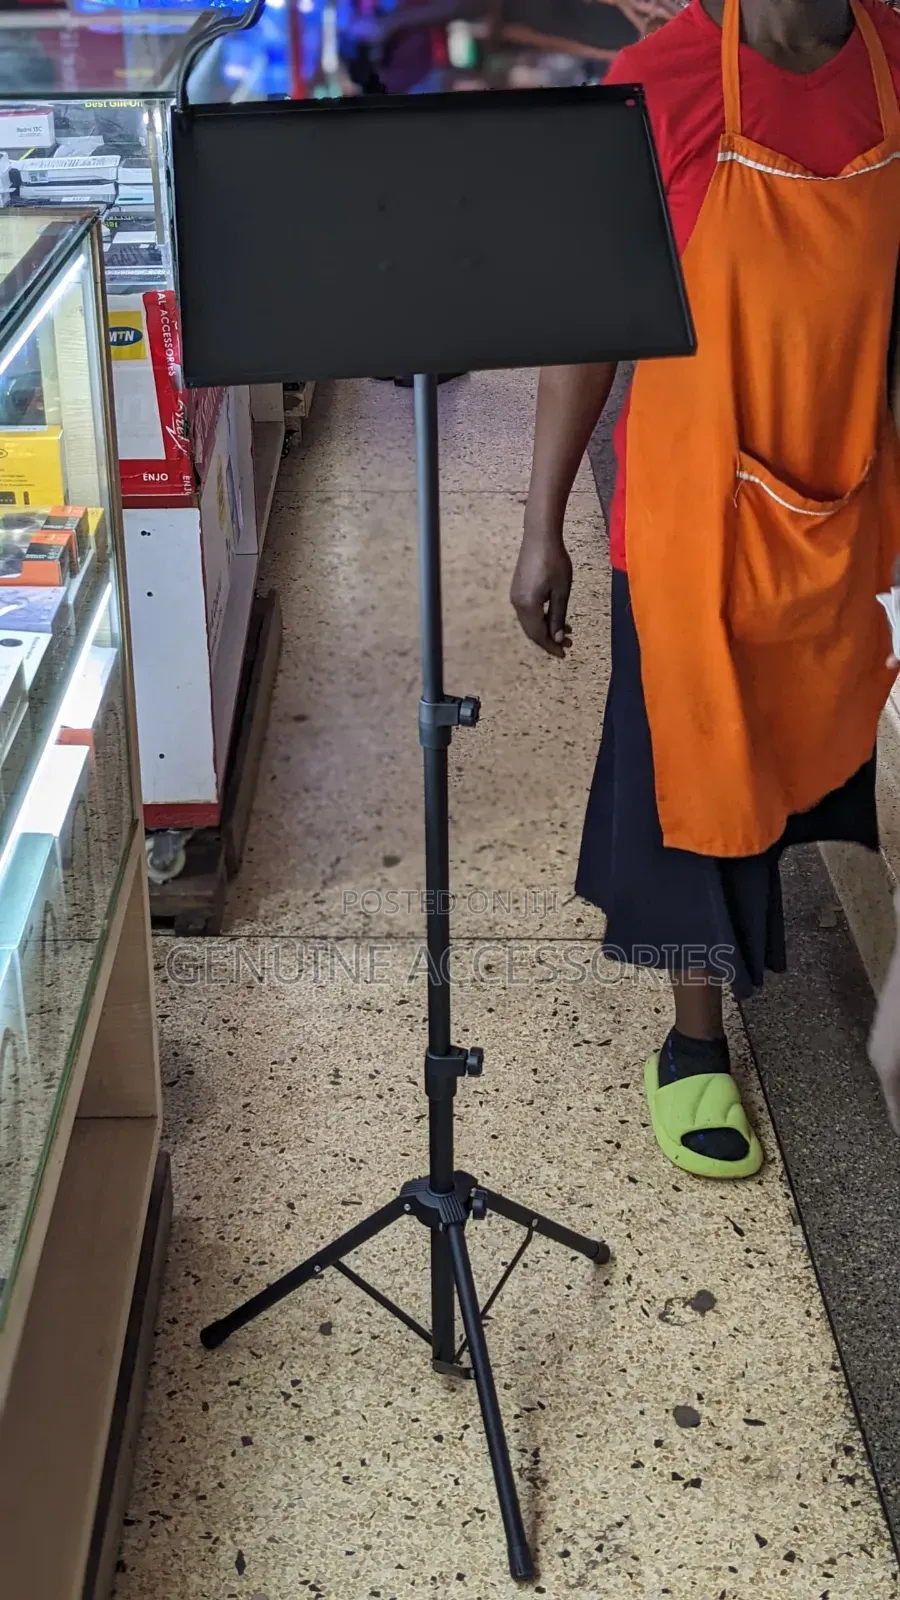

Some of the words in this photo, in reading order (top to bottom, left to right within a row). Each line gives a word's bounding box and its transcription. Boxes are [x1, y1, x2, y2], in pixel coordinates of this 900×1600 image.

[156, 290, 167, 306] AL
[160, 309, 177, 377] ACCESSORIES
[142, 473, 169, 482] ENJO
